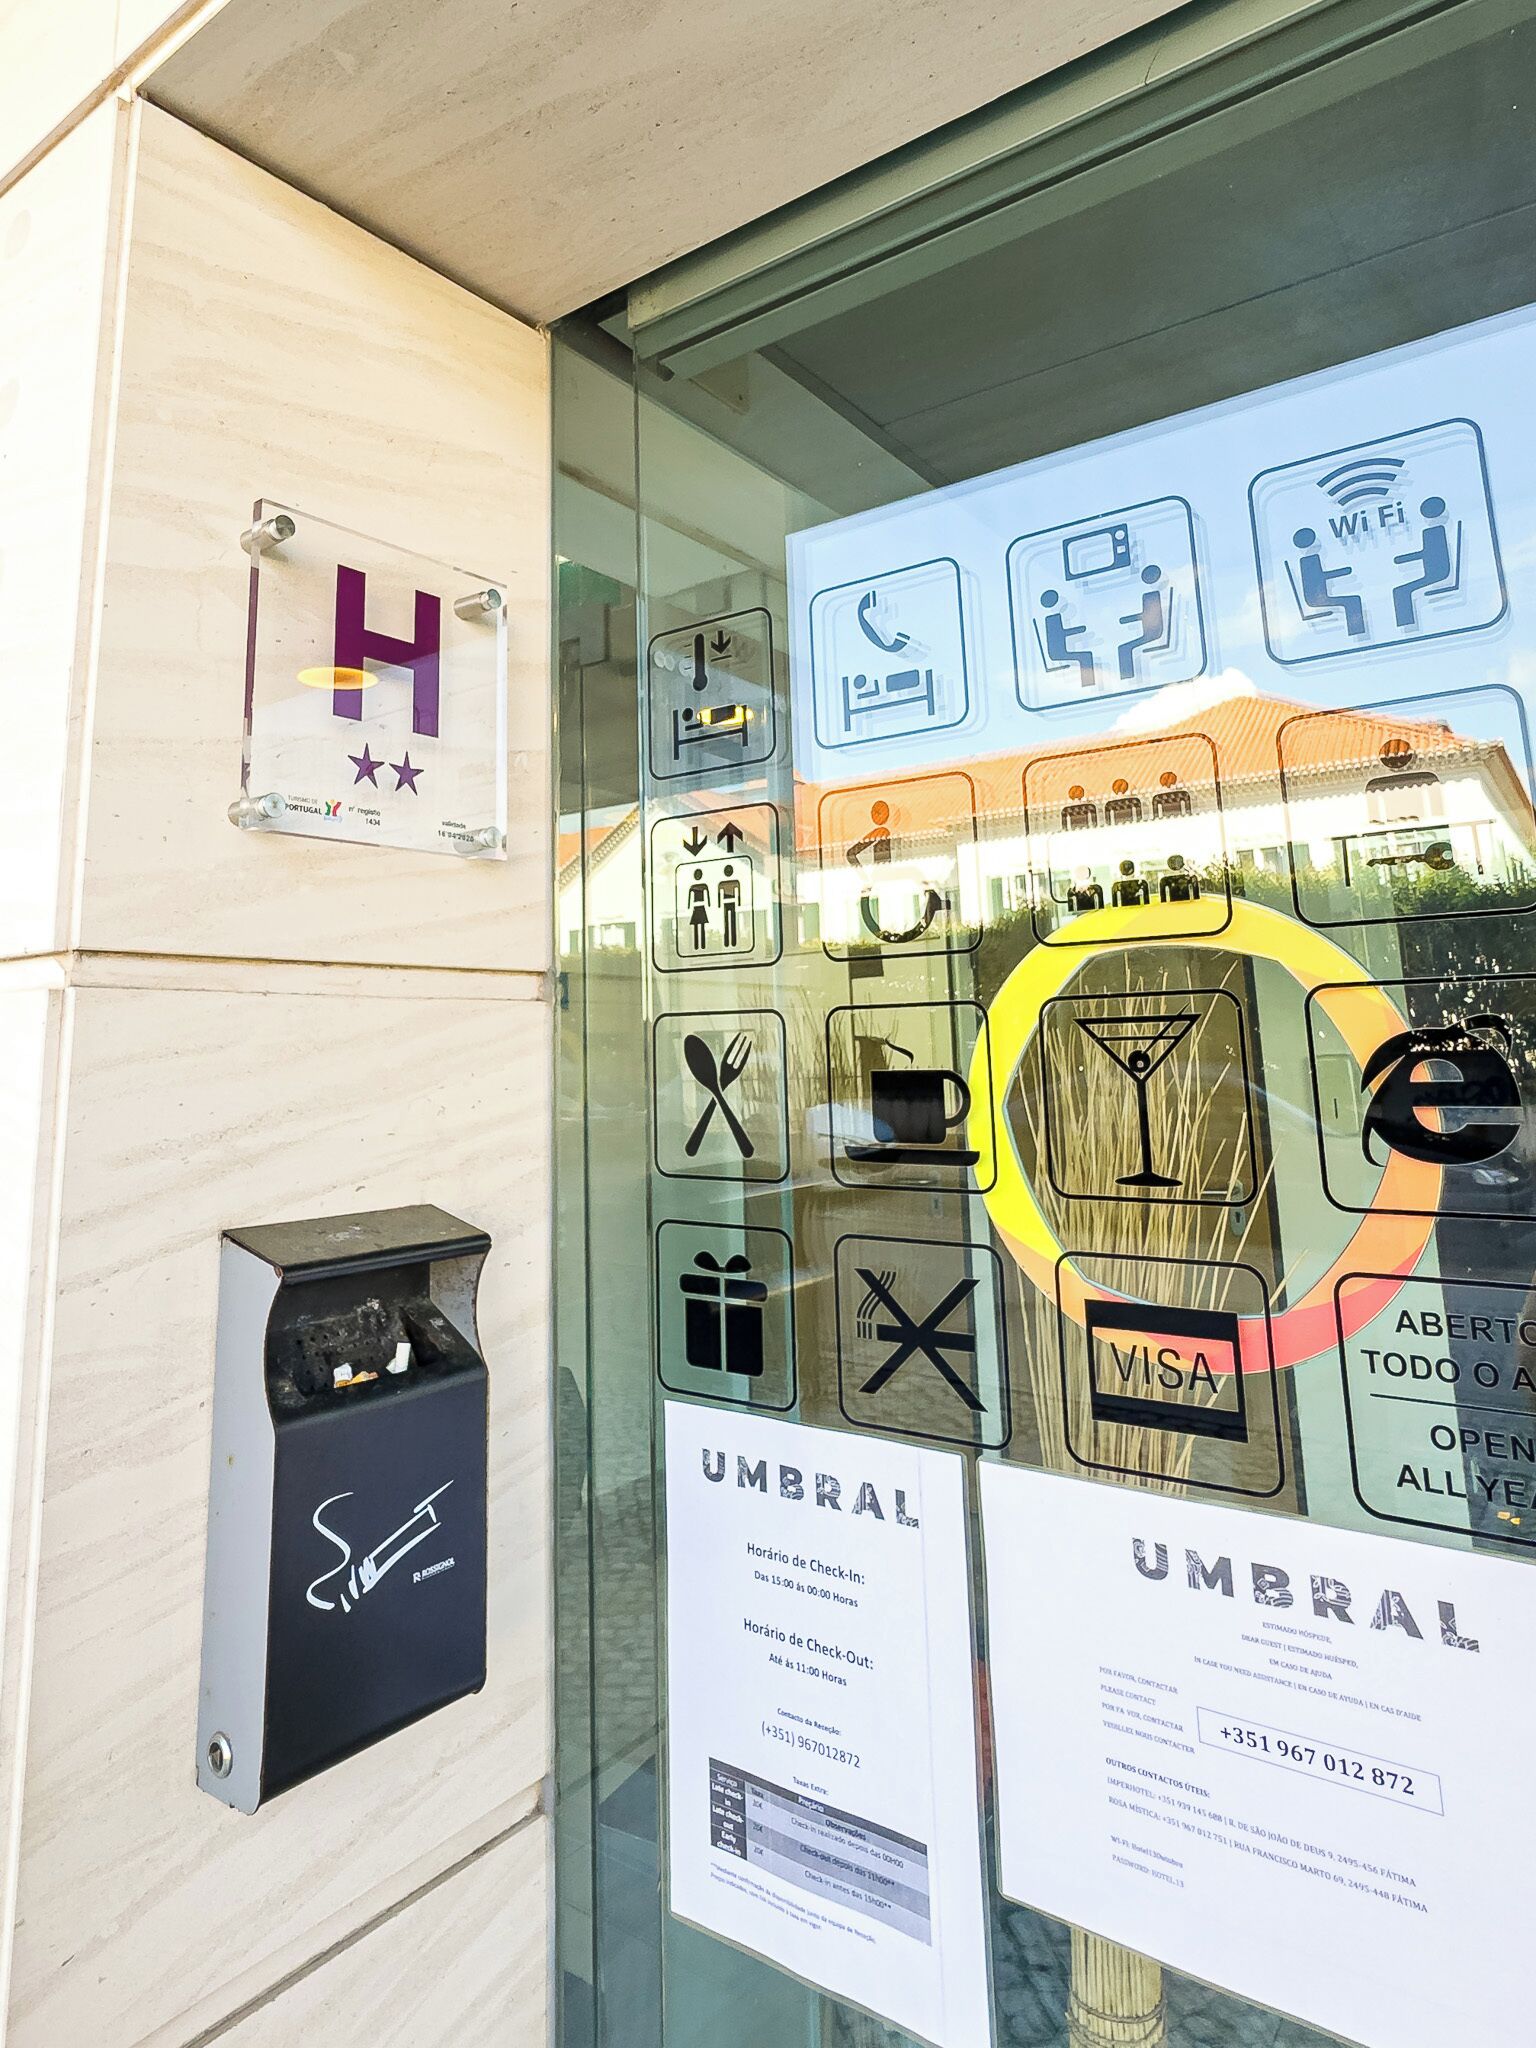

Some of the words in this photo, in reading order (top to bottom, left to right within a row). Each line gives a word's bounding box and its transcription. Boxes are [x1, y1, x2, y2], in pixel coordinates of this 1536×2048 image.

[1328, 510, 1369, 538] Wi
[1377, 501, 1405, 528] Fi
[333, 563, 441, 738] H
[285, 803, 323, 815] PORTUGAL
[1109, 1342, 1219, 1394] VISA
[1360, 1348, 1462, 1384] TODO
[1473, 1361, 1500, 1389] O
[1429, 1424, 1536, 1464] OPEN
[701, 1447, 920, 1529] UMBRAL
[1396, 1463, 1468, 1499] ALL
[1474, 1473, 1536, 1510] YE
[747, 1542, 789, 1565] Horário
[792, 1555, 807, 1569] de
[809, 1559, 865, 1585] Check-In:
[754, 1570, 769, 1583] Das
[771, 1574, 794, 1589] 15:00
[806, 1584, 831, 1600] 00:00
[833, 1592, 859, 1608] Horas
[1132, 1537, 1481, 1653] UMBRAL
[743, 1618, 786, 1642] Horário
[789, 1632, 804, 1648] de
[806, 1638, 875, 1670] Check-Out:
[1241, 1633, 1260, 1645] DEAR
[1260, 1637, 1282, 1650] GUEST
[1286, 1644, 1323, 1660] ESTIMADO
[1262, 1621, 1299, 1636] ESTIMADO
[769, 1652, 783, 1666] Até
[796, 1661, 820, 1678] 11:00
[821, 1670, 848, 1687] Horas
[1099, 1665, 1113, 1676] POR
[1137, 1676, 1178, 1695] CONTACTAR
[1269, 1658, 1280, 1667] EM
[1280, 1660, 1299, 1673] CASO
[1299, 1665, 1309, 1675] DE
[1310, 1668, 1333, 1681] AJUDA
[1100, 1684, 1124, 1697] PLEASE
[1125, 1690, 1157, 1706] CONTACT
[1194, 1655, 1202, 1664] IN
[1202, 1658, 1219, 1670] CASE
[1219, 1662, 1234, 1674] YOU
[1233, 1666, 1252, 1678] NEED
[1252, 1671, 1293, 1690] ASSISTANCE
[1297, 1682, 1308, 1692] EN
[1308, 1685, 1328, 1698] CASO
[1328, 1690, 1338, 1700] DE
[1338, 1693, 1364, 1707] AYUDA
[1369, 1701, 1381, 1711] EN
[1381, 1704, 1396, 1716] CAS
[1396, 1707, 1422, 1723] D'AIDE
[777, 1707, 804, 1724] Contacto
[804, 1717, 813, 1726] da
[1101, 1702, 1115, 1712] POR
[1142, 1714, 1184, 1733] CONTACTAR
[761, 1720, 795, 1748] (+351)
[797, 1735, 861, 1769] 967012872
[1135, 1729, 1154, 1741] NOUS
[1153, 1735, 1196, 1755] CONTACTER
[1220, 1724, 1271, 1753] +351
[1276, 1739, 1317, 1766] 967
[1323, 1753, 1365, 1782] 012
[1371, 1766, 1416, 1796] 872
[793, 1776, 810, 1790] Taxas
[1105, 1757, 1137, 1774] OUTROS
[1137, 1767, 1184, 1790] CONTACTOS
[1184, 1782, 1211, 1799] ÚTEIS:
[1107, 1776, 1156, 1800] IMPERHOTEL:
[1158, 1794, 1176, 1807] +351
[1192, 1805, 1207, 1817] 145
[1237, 1820, 1249, 1832] DE
[1250, 1824, 1267, 1838] SÃO
[1267, 1830, 1289, 1846] JOÃO
[1290, 1838, 1302, 1850] DE
[1303, 1843, 1326, 1858] DEUS
[1337, 1854, 1379, 1875] 2495-456
[1379, 1866, 1417, 1888] FÁTIMA
[831, 1857, 854, 1873] depois
[854, 1866, 867, 1877] das
[869, 1848, 881, 1859] das
[1108, 1796, 1128, 1809] ROSA
[1128, 1801, 1161, 1822] MÍSTICA:
[1162, 1816, 1180, 1829] +351
[1181, 1822, 1196, 1834] 967
[1196, 1827, 1212, 1840] 012
[1212, 1833, 1228, 1846] 751
[1233, 1839, 1251, 1854] RUA
[1251, 1846, 1299, 1870] FRANCISCO
[1299, 1863, 1332, 1881] MARTO
[1332, 1873, 1347, 1887] 69,
[1347, 1879, 1391, 1901] 2495-448
[1391, 1893, 1429, 1914] FÁTIMA
[832, 1881, 850, 1894] antes
[851, 1890, 863, 1900] das
